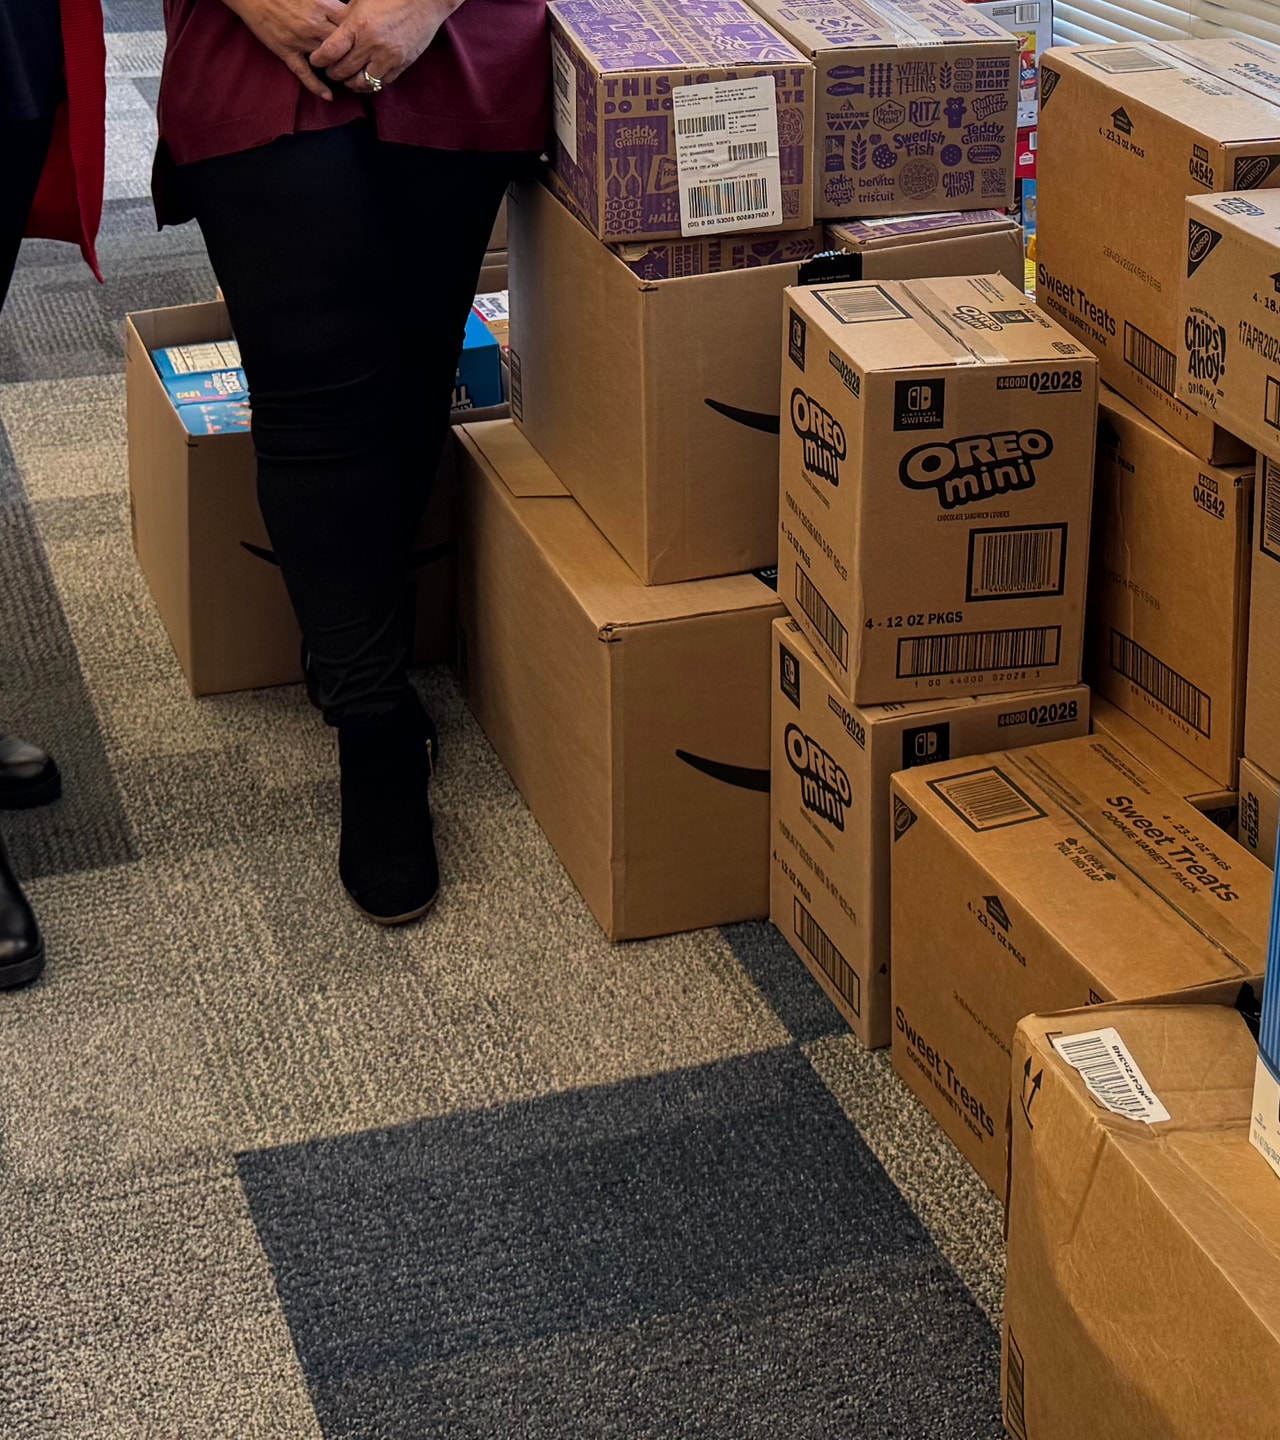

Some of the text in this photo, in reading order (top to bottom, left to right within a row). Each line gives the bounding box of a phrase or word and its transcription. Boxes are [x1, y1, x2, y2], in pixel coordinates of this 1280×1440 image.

[895, 62, 938, 78] WHEAT
[975, 69, 1010, 79] MADE
[604, 75, 671, 97] THIS
[896, 74, 937, 95] THINS
[975, 79, 1010, 89] RIGHT
[604, 101, 633, 114] DO
[909, 101, 941, 123] RITZ
[972, 93, 1007, 110] Nutter
[976, 103, 1008, 120] Butter
[826, 111, 870, 120] TOBLERONE
[875, 107, 902, 119] Honey
[878, 115, 899, 125] Maid
[617, 125, 657, 139] Teddy
[893, 130, 946, 149] Swedish
[961, 133, 1006, 145] Grahams
[963, 122, 1004, 136] Teddy
[614, 135, 660, 148] Grahams
[905, 143, 935, 157] Fish
[942, 171, 971, 188] Chips
[1189, 158, 1214, 186] 04542
[826, 182, 853, 193] SOUR
[858, 192, 896, 203] triscuit
[648, 213, 680, 224] HALL
[1038, 263, 1075, 307] Sweet
[1076, 288, 1116, 336] Treats
[1047, 296, 1068, 318] COOKIE
[1068, 312, 1091, 336] VARIETY
[1091, 330, 1108, 347] PACK
[1185, 315, 1220, 353] Chips
[997, 371, 1082, 392] 44000 02028
[1188, 382, 1218, 410] ORIGINAL
[792, 390, 846, 457] OREO
[901, 416, 937, 425] SWITCH
[805, 437, 838, 484] mini
[904, 431, 1050, 484] OREO
[942, 458, 1032, 504] mini
[1193, 485, 1225, 519] 04542
[865, 611, 963, 630] 4 12 OZ PKGS
[949, 674, 984, 686] 44000
[1028, 701, 1078, 725] 02028
[841, 708, 866, 750] 02028
[787, 725, 851, 805] OREO
[803, 773, 844, 830] mini
[1247, 791, 1260, 849] 05222
[1075, 844, 1088, 855] TO
[1101, 810, 1202, 894] COOKIE VARIETY PACK
[1106, 795, 1240, 902] Sweet Treats
[1172, 822, 1232, 872] 23.3 OZ PKGS
[1053, 840, 1104, 883] PULL THIS FLAP
[976, 908, 996, 937] 23.3
[996, 930, 1008, 949] OZ
[895, 1006, 995, 1137] Sweet Treats
